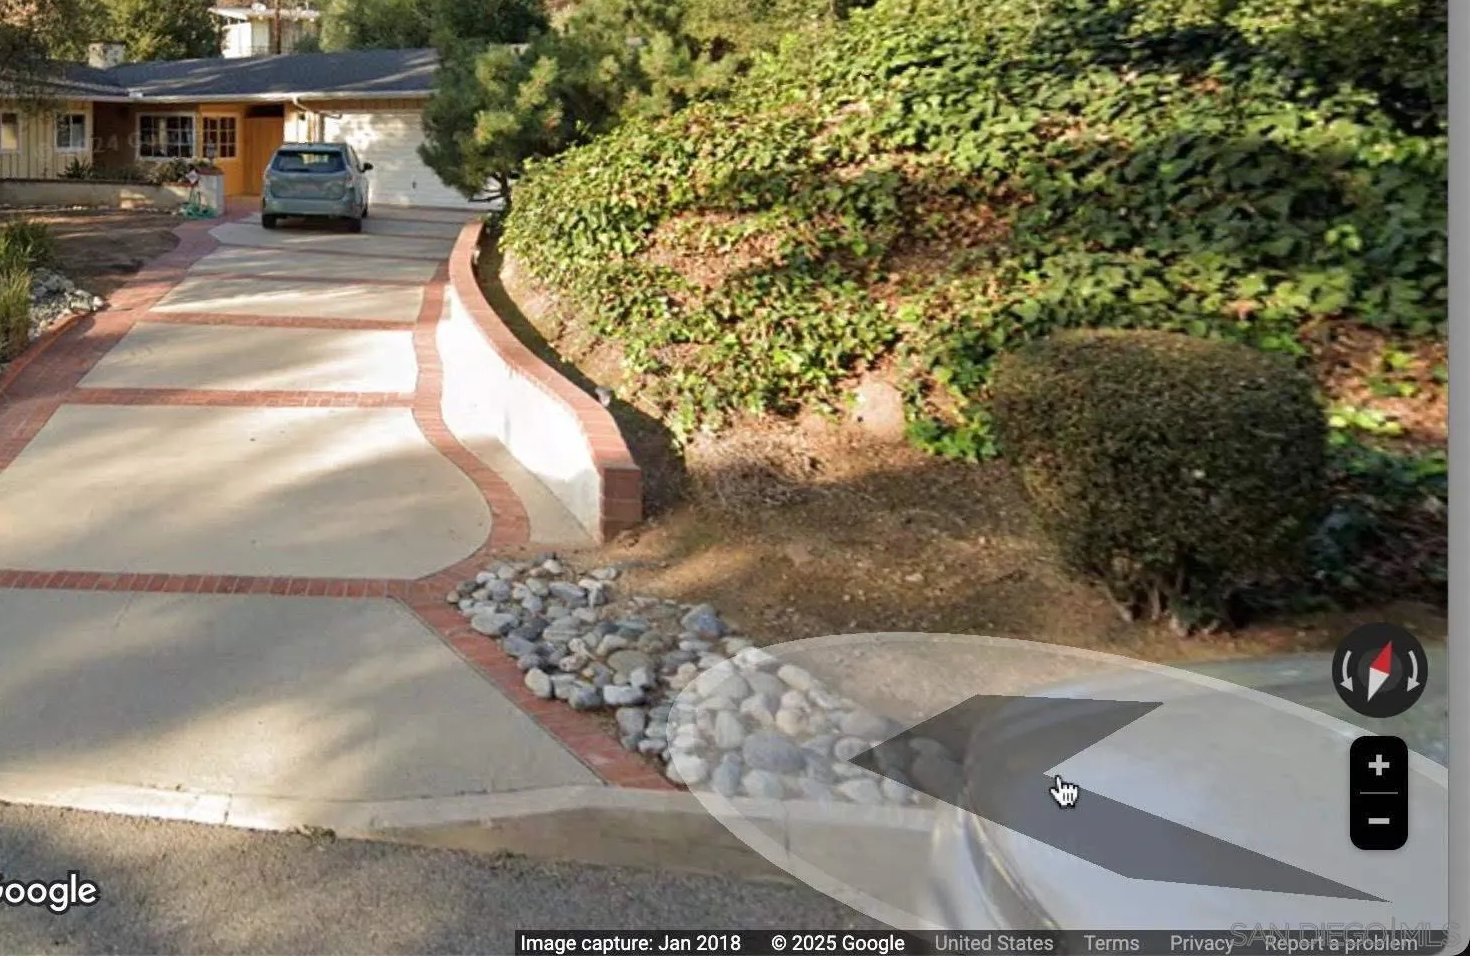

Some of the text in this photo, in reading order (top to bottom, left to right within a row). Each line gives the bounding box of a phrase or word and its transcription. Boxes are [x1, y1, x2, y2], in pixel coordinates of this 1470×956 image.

[521, 934, 741, 955] Image capture: Jan 2018
[791, 934, 837, 951] 2025
[841, 933, 906, 955] Google
[935, 934, 1055, 951] United States
[1083, 934, 1140, 951] Terms
[1170, 934, 1235, 955] Privacy
[1265, 934, 1418, 954] Report a problem
